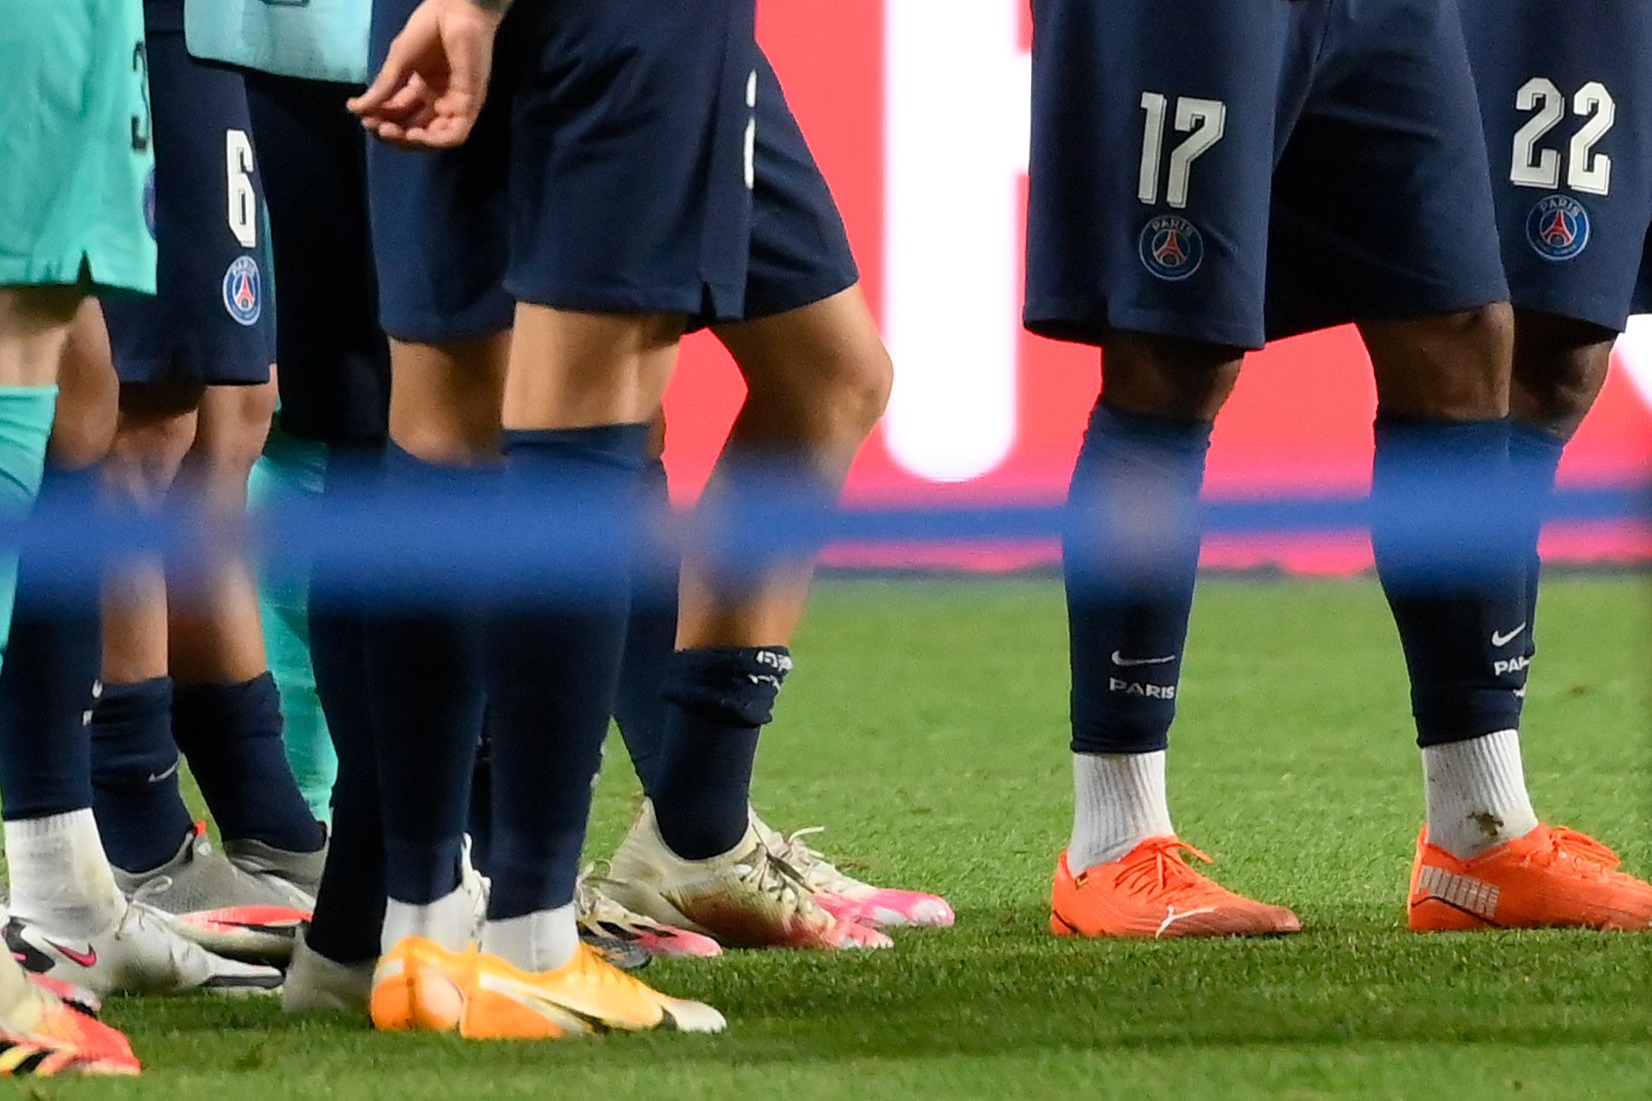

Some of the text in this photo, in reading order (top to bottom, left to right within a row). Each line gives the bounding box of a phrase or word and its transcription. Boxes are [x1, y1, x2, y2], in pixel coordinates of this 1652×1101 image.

[226, 129, 257, 247] 6
[1137, 91, 1227, 209] 17
[1510, 77, 1616, 196] 22
[1540, 198, 1581, 217] PARIS
[1109, 677, 1175, 700] PARIS
